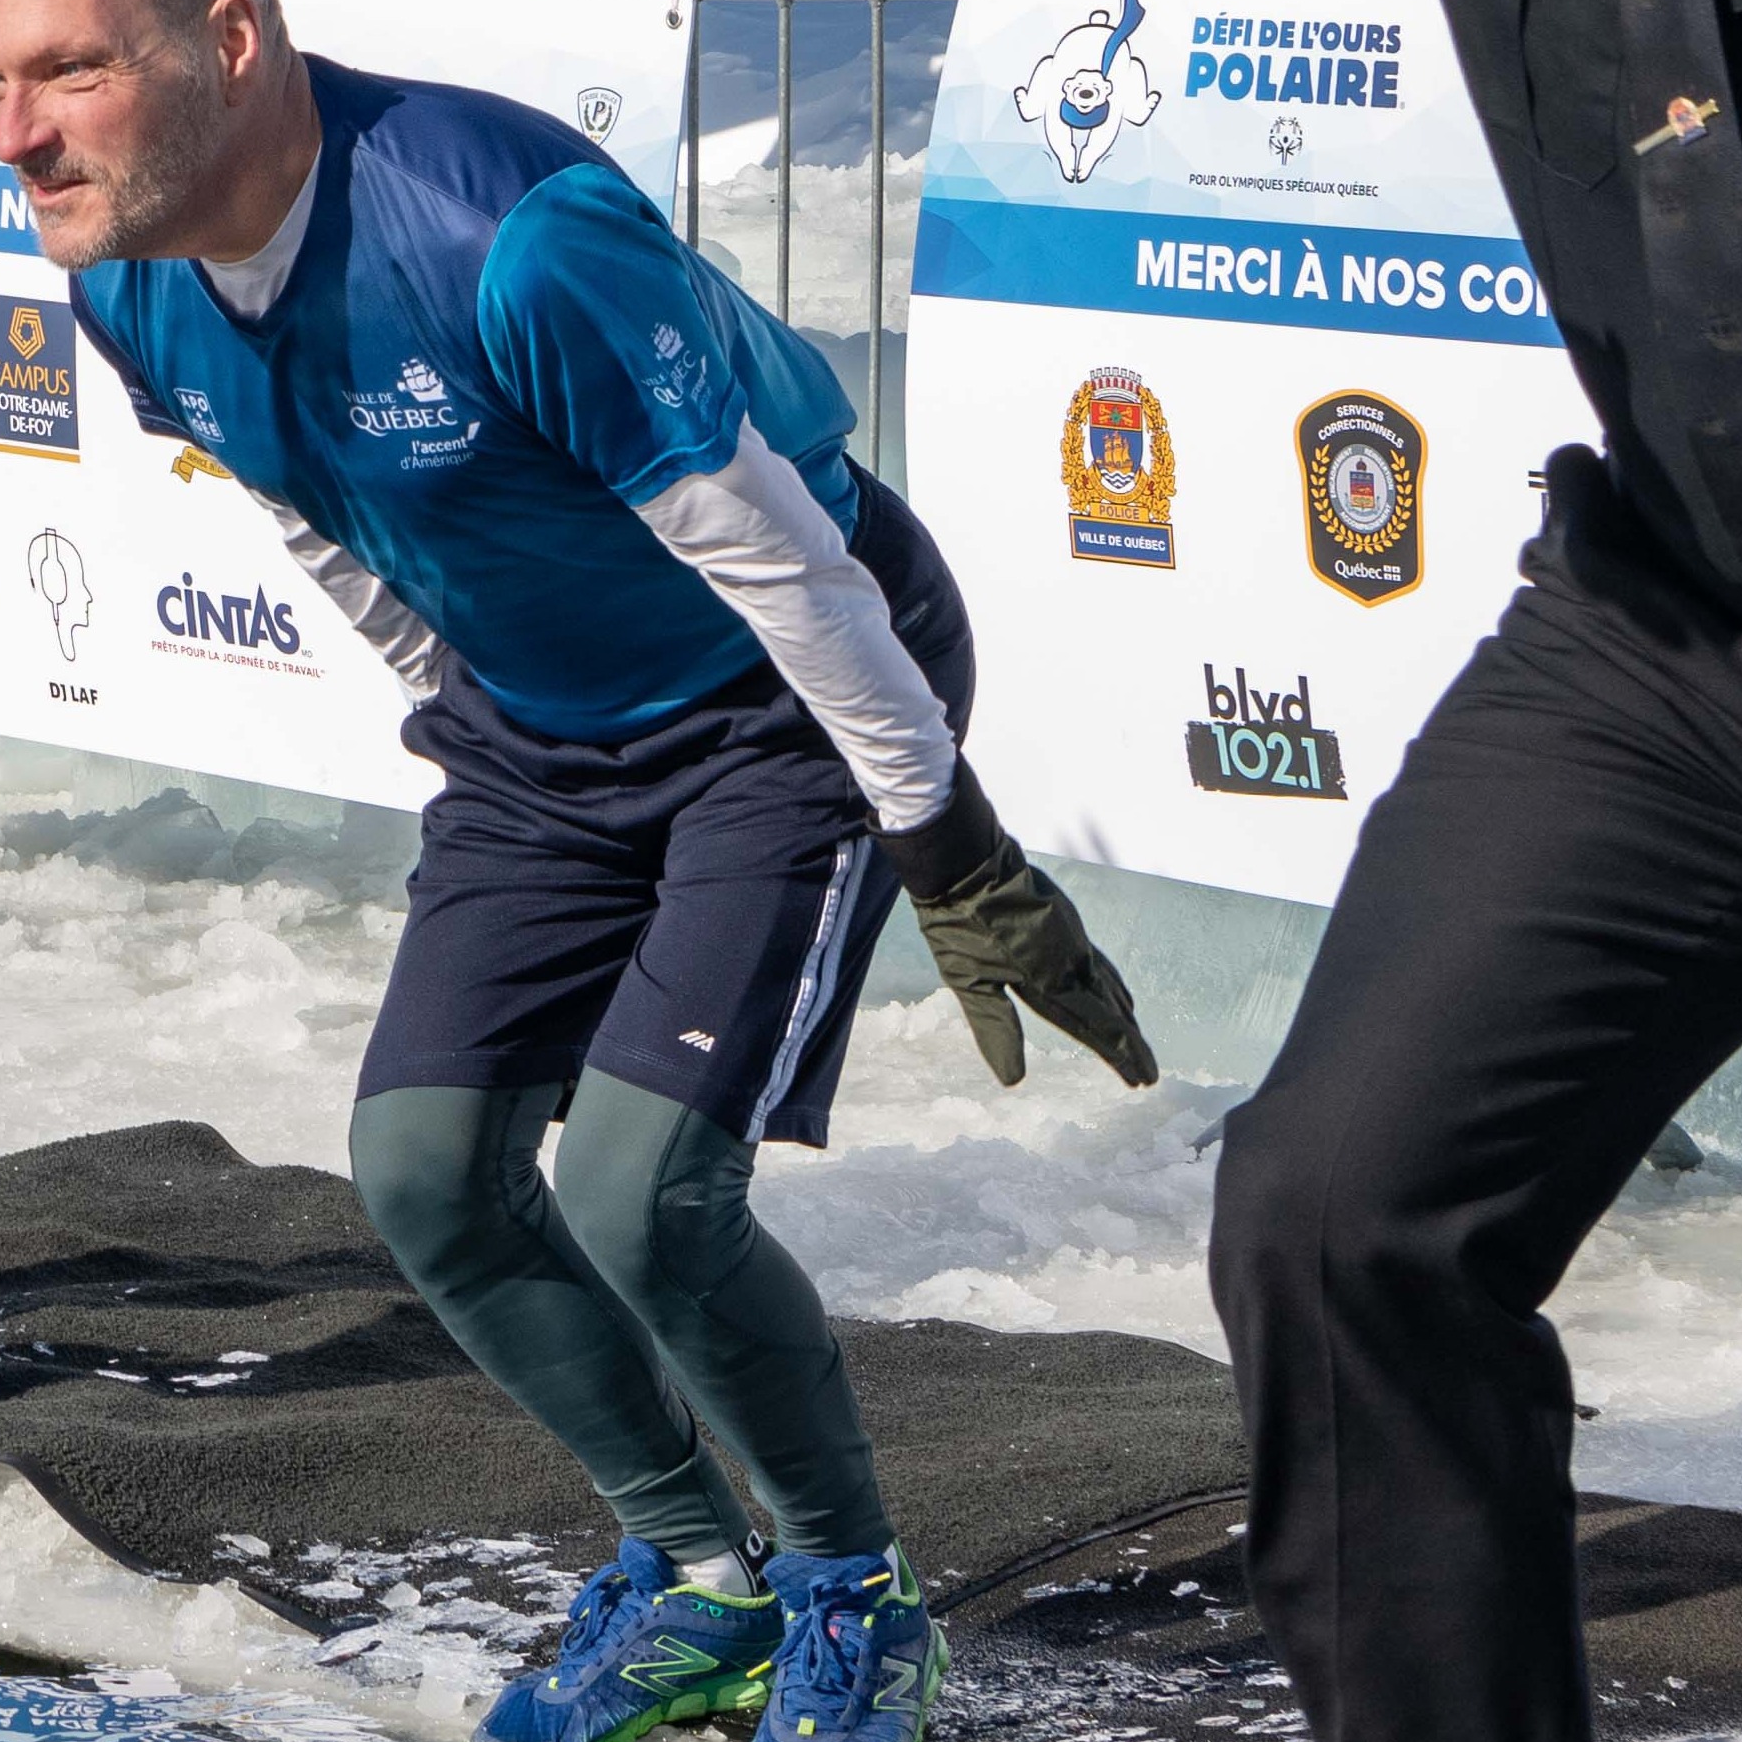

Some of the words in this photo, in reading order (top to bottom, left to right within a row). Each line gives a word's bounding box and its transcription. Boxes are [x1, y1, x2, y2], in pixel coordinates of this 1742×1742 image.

[1191, 11, 1254, 47] DÉFI
[1258, 19, 1296, 49] DE
[1300, 21, 1402, 54] L'OURS
[1184, 51, 1400, 109] POLAIRE
[1189, 173, 1217, 188] POUR
[1218, 175, 1285, 192] OLYMPIQUES
[1285, 177, 1335, 195] SPÉCIAUX
[1337, 180, 1379, 198] QUÉBEC
[1135, 238, 1282, 295] MERCI
[1293, 238, 1330, 302] À
[1341, 258, 1447, 311] NOS
[341, 389, 375, 406] VILLE
[378, 391, 397, 405] DE
[9, 414, 55, 438] DE-FOY
[349, 404, 459, 438] QUÉBEC
[1335, 404, 1386, 423] SERVICES
[411, 436, 469, 456] l'accent
[1317, 418, 1405, 450] CORRECTIONNELS
[1099, 505, 1140, 520] POLICE
[1078, 531, 1107, 545] VILLE
[1107, 534, 1123, 547] DE
[1123, 536, 1167, 552] QUÉBEC
[1334, 559, 1384, 580] Québec
[151, 640, 179, 655] PRÊTS
[180, 645, 206, 658] POUR
[208, 650, 220, 662] LA
[222, 653, 265, 670] JOURNÉE
[267, 660, 281, 672] DE
[282, 662, 321, 679] TRAVAIL
[48, 681, 68, 702] DJ
[69, 685, 99, 706] LAF
[1203, 661, 1313, 729] blvd
[1209, 723, 1322, 791] 102.1
